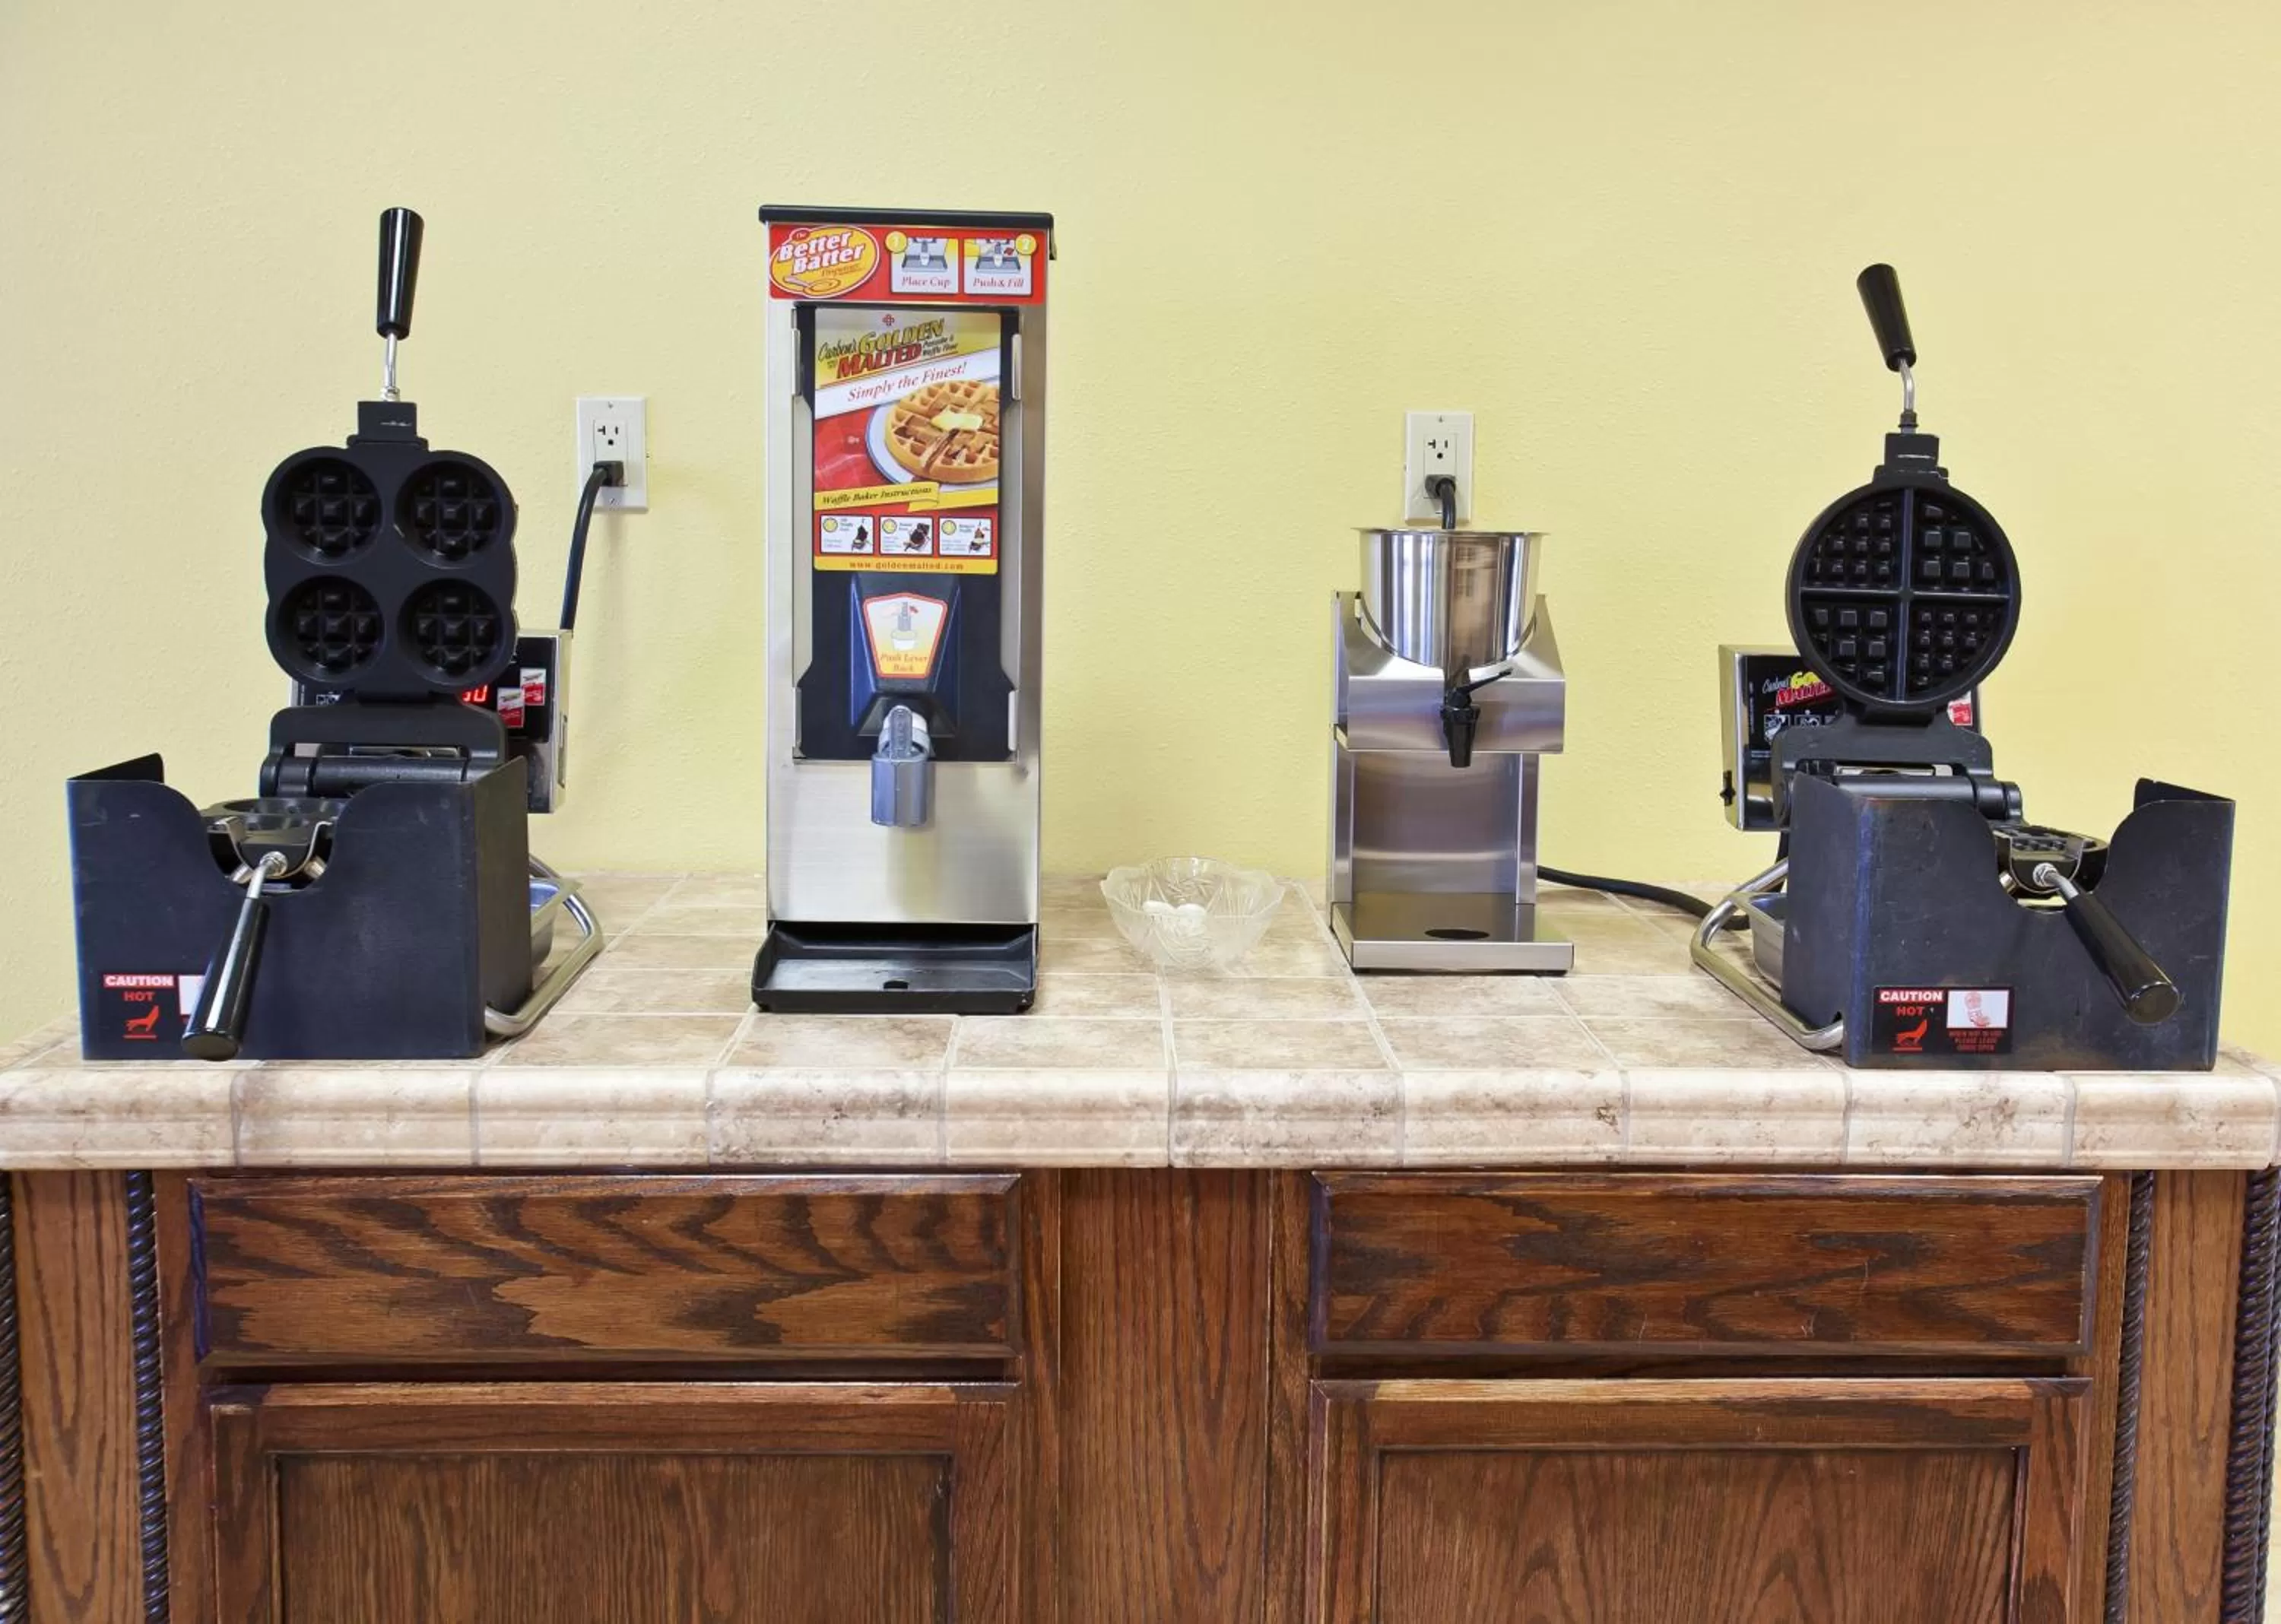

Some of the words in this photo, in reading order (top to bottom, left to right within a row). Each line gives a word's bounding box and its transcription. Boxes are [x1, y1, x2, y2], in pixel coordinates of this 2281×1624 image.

[777, 231, 852, 262] Better
[791, 243, 865, 275] Batter
[902, 277, 928, 287] Place
[930, 276, 950, 289] Cup
[1007, 278, 1024, 287] Fill
[858, 318, 944, 356] GOLDEN
[836, 342, 922, 379] MALTED
[847, 379, 895, 402] Simply
[898, 373, 919, 389] the
[922, 362, 967, 385] Finest!
[823, 493, 851, 505] Waffle
[853, 492, 878, 501] Baker
[880, 487, 932, 499] Instructions
[105, 975, 174, 987] CAUTION
[123, 991, 155, 1001] HOT
[1880, 991, 1943, 1001] CAUTION
[1896, 1006, 1925, 1017] HOT
